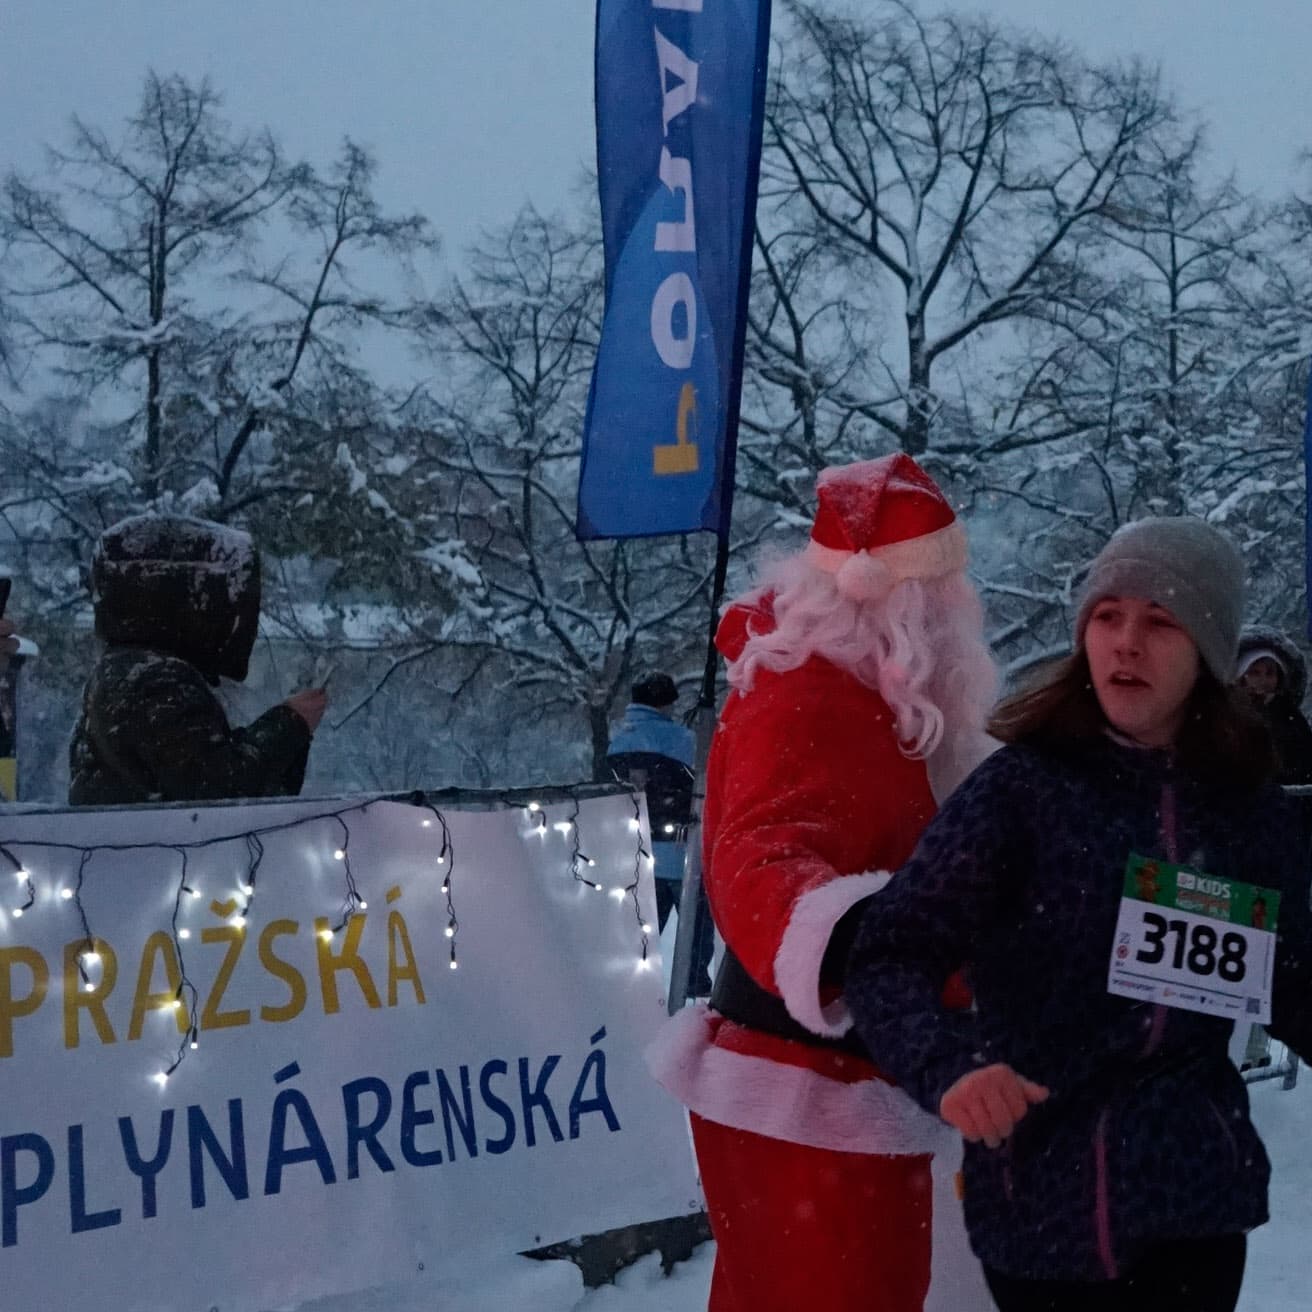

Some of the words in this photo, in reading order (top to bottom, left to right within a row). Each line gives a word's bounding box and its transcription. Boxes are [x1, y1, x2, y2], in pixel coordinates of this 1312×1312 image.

[1136, 911, 1248, 983] 3188
[1197, 876, 1232, 899] KIDS
[0, 886, 427, 1058] PRAŽSKÁ
[1, 1026, 621, 1247] PLYNÁRENSKÁ
